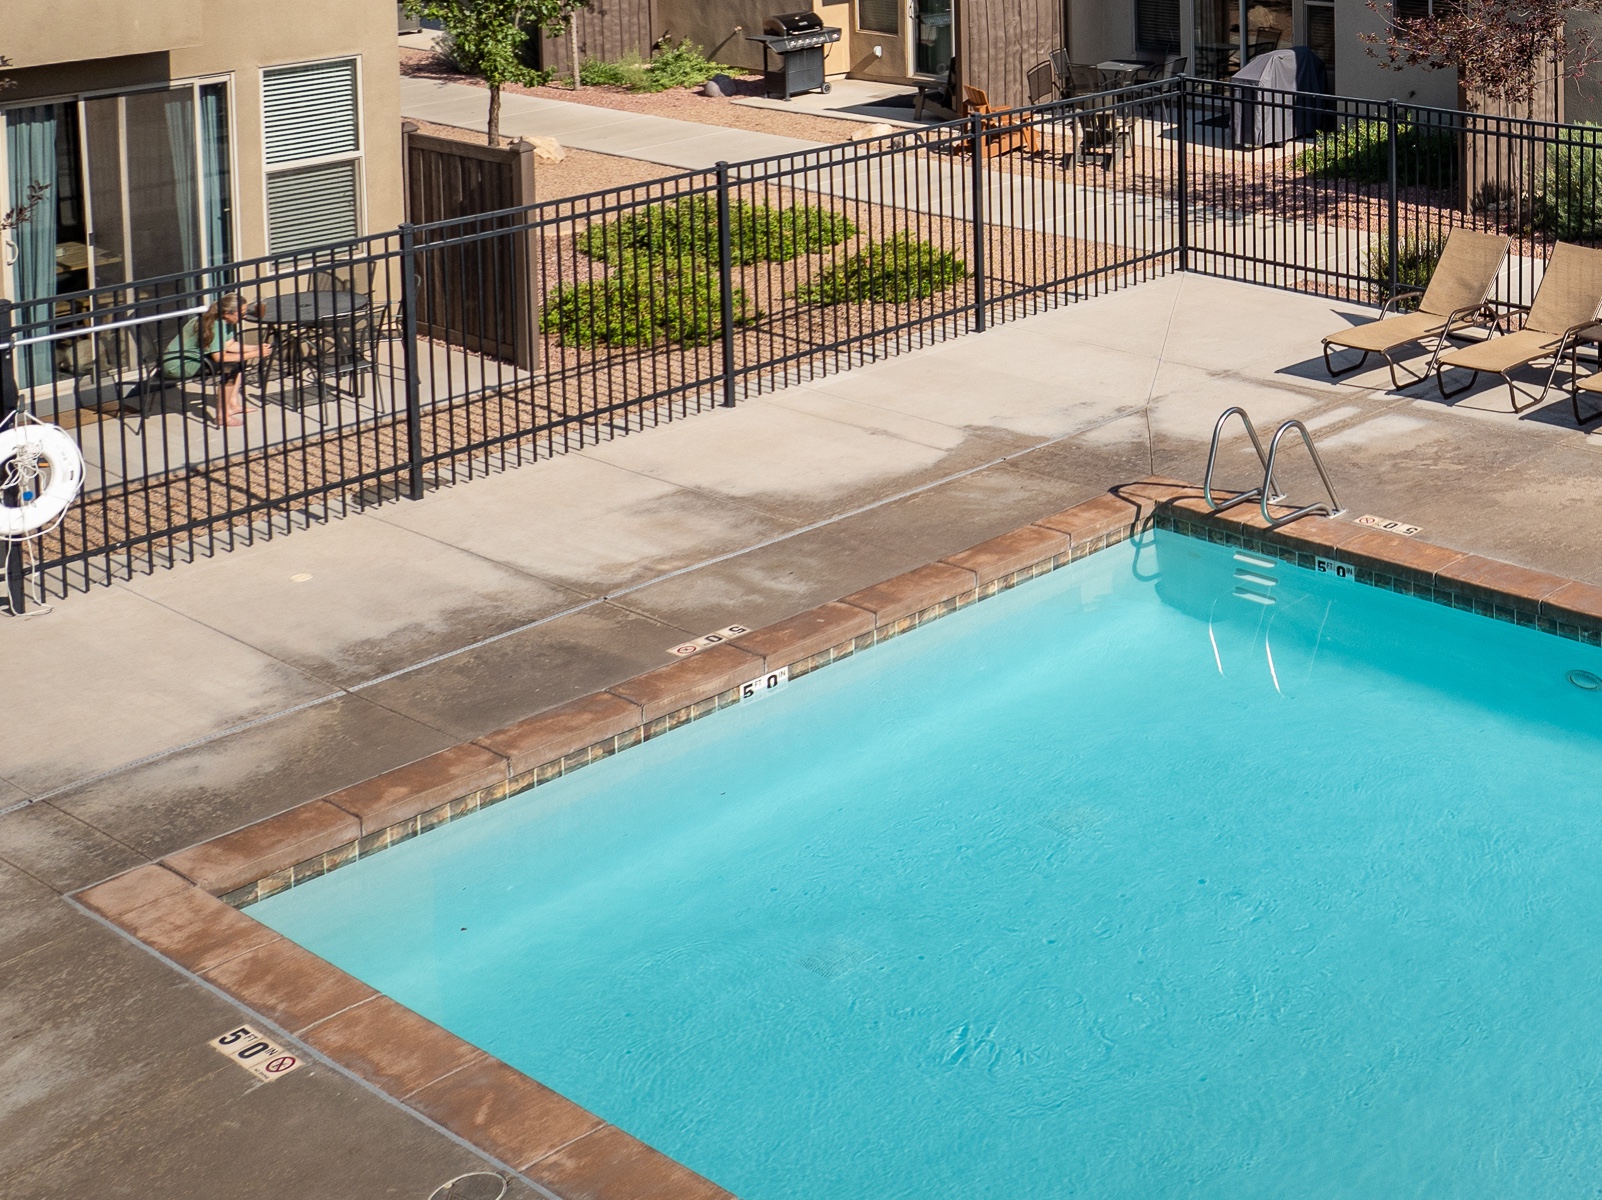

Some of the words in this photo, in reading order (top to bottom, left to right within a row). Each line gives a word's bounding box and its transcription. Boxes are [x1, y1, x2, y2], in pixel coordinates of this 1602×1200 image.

[1403, 527, 1418, 535] 5
[1317, 561, 1327, 572] 5
[729, 626, 747, 634] 5
[743, 684, 754, 698] 5
[767, 674, 778, 689] 0
[779, 669, 786, 677] IN
[218, 1027, 251, 1045] 5
[243, 1033, 258, 1042] FT
[238, 1042, 269, 1059] 0
[264, 1047, 278, 1056] IN
